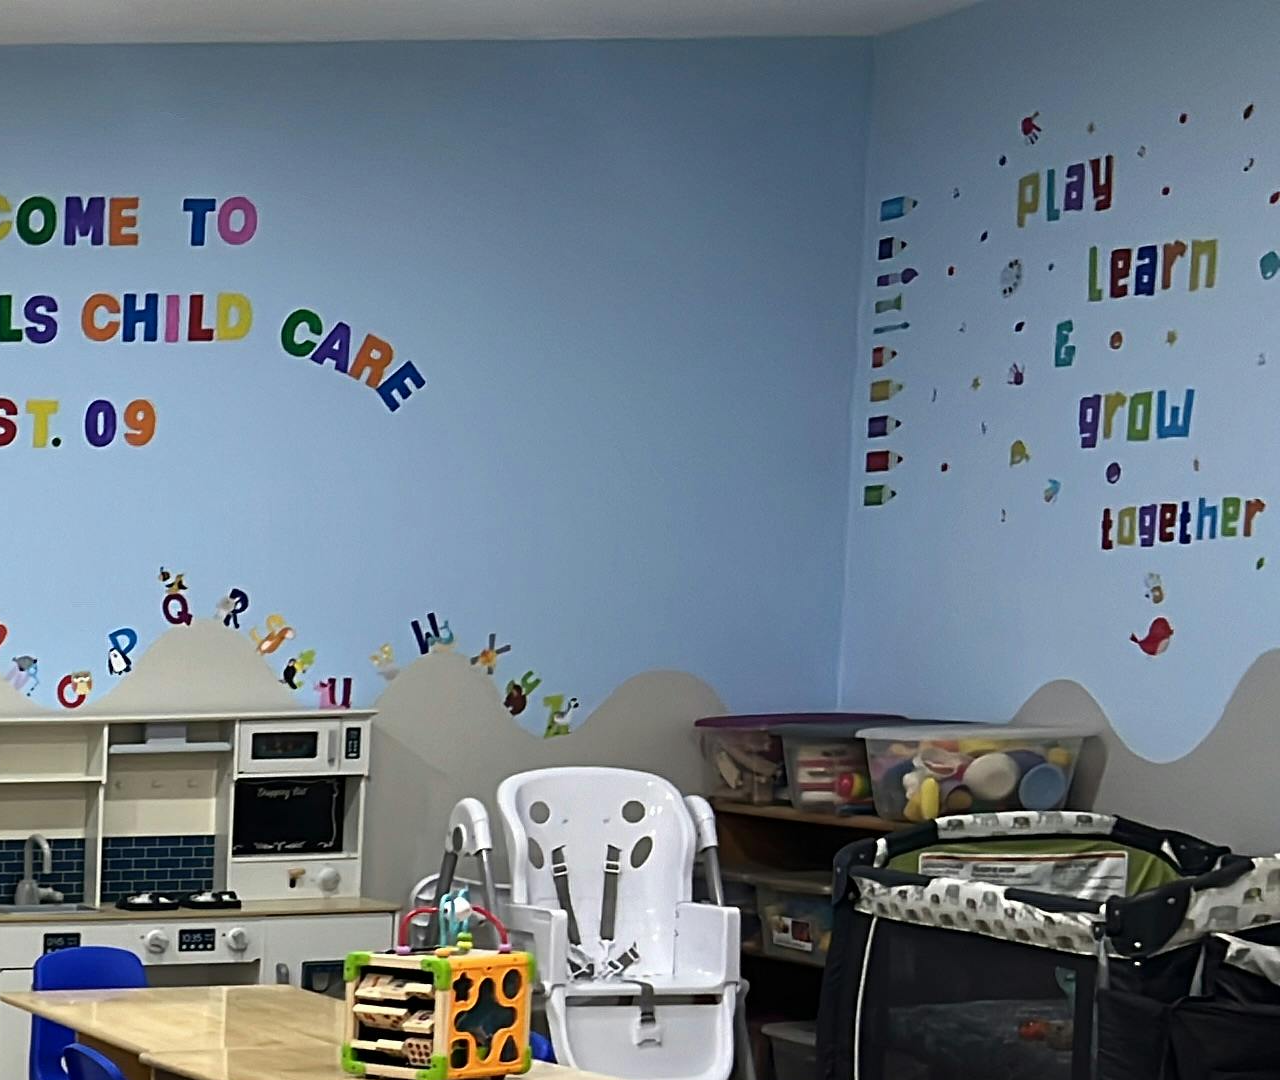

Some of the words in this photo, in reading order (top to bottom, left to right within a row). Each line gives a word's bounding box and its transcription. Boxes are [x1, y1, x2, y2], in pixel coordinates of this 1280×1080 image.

[183, 196, 258, 246] TO
[81, 292, 253, 343] CHILD
[280, 308, 425, 412] CARE
[85, 398, 155, 447] 09
[1080, 388, 1195, 448] grow
[1101, 497, 1266, 550] together
[163, 593, 192, 626] Q
